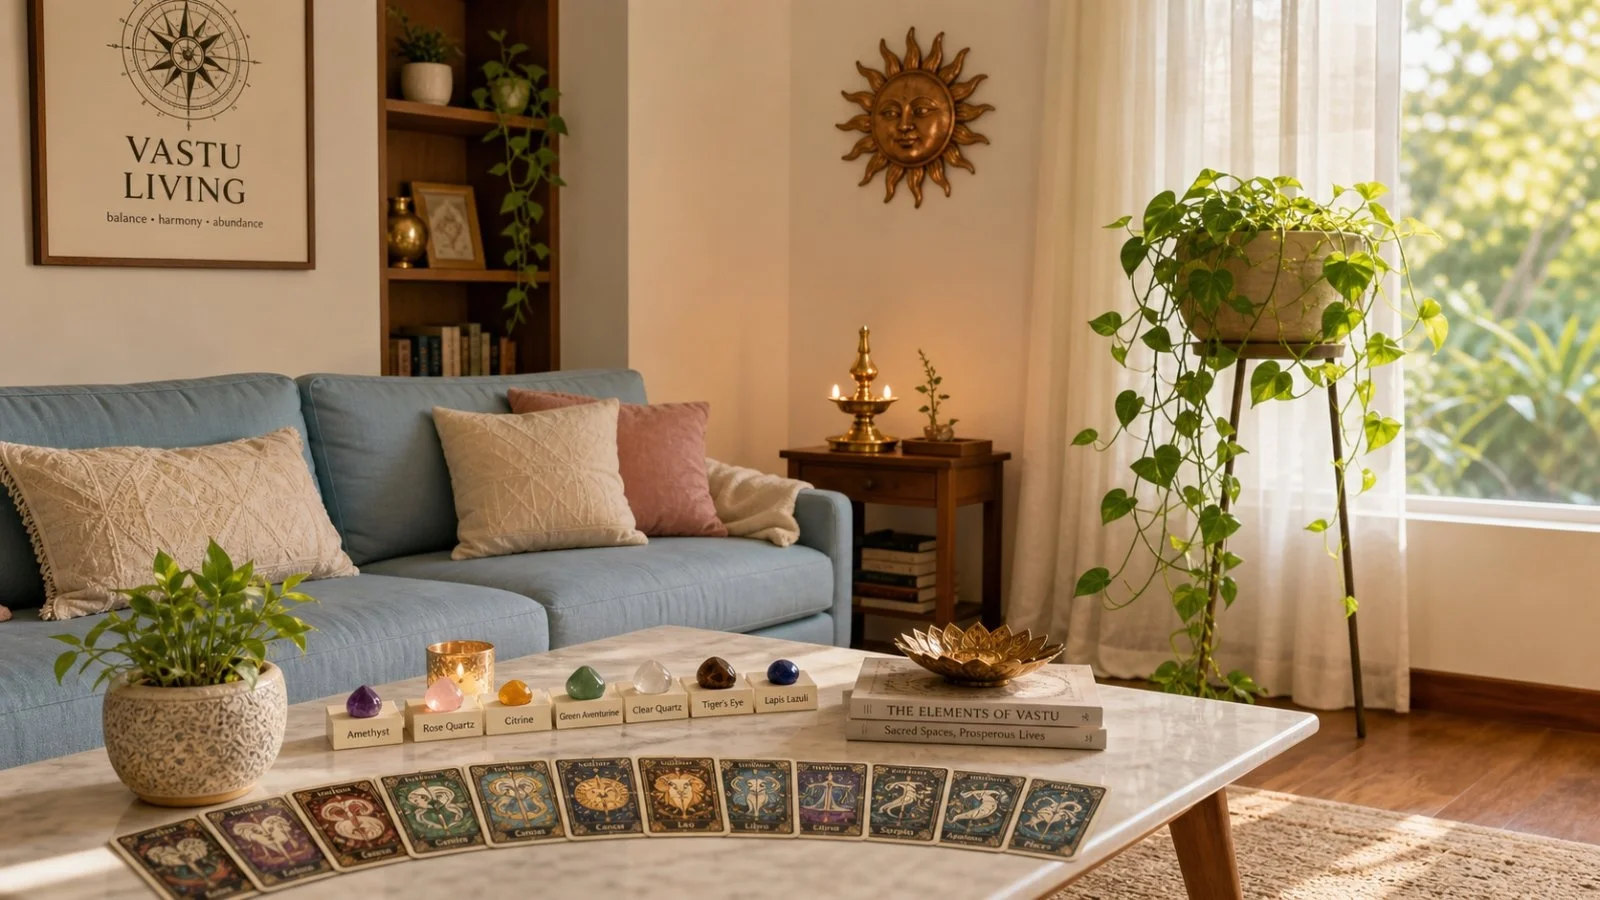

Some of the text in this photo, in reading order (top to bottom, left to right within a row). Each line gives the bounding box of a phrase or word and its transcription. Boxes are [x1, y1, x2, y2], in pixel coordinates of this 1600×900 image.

[125, 135, 242, 169] VASTU
[124, 171, 245, 205] LIVING
[107, 212, 263, 228] balance harmony abundance
[702, 699, 744, 710] Tiger's Eye
[765, 694, 808, 706] Lapis Lazuli
[581, 710, 620, 719] Aventurine
[632, 704, 683, 714] Clear Quartz
[887, 705, 1059, 721] THE ELEMENTS OF VASTU
[505, 716, 533, 725] Citrine
[424, 722, 474, 732] Rose Quartz
[885, 725, 1045, 741] Sacred Spaces, Prosperous Lives
[347, 727, 390, 740] Amethyst
